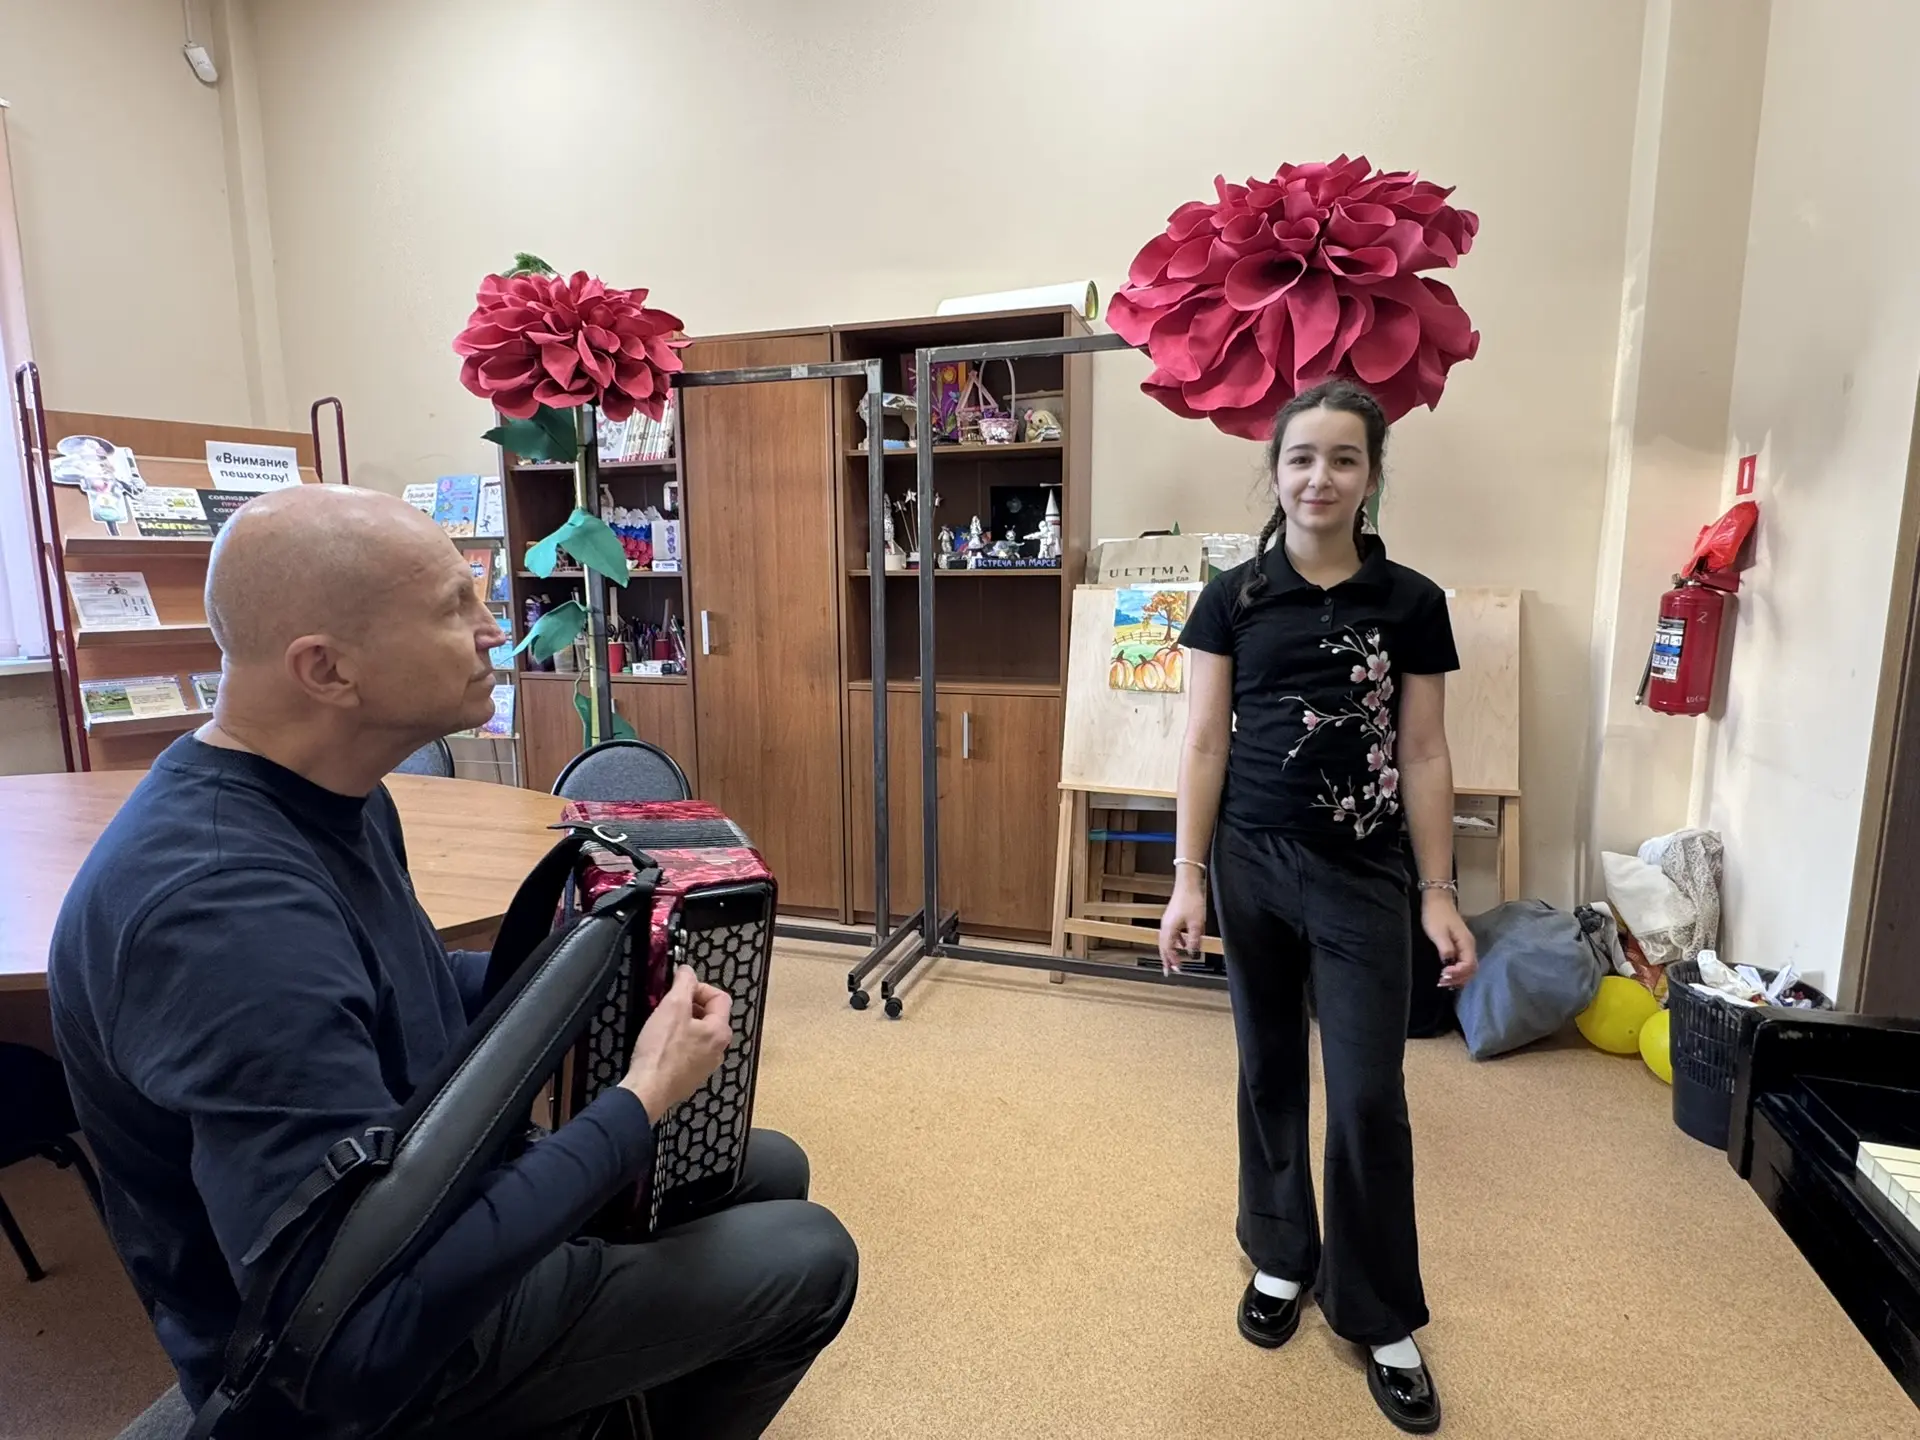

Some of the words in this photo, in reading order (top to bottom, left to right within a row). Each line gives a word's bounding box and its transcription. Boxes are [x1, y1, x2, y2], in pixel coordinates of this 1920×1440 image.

[215, 452, 289, 469] «Внимание
[220, 470, 290, 482] пешеходу!
[977, 559, 1012, 567] ВСТРЕЧА
[1015, 559, 1026, 567] НА
[1109, 565, 1190, 578] ULTIMA
